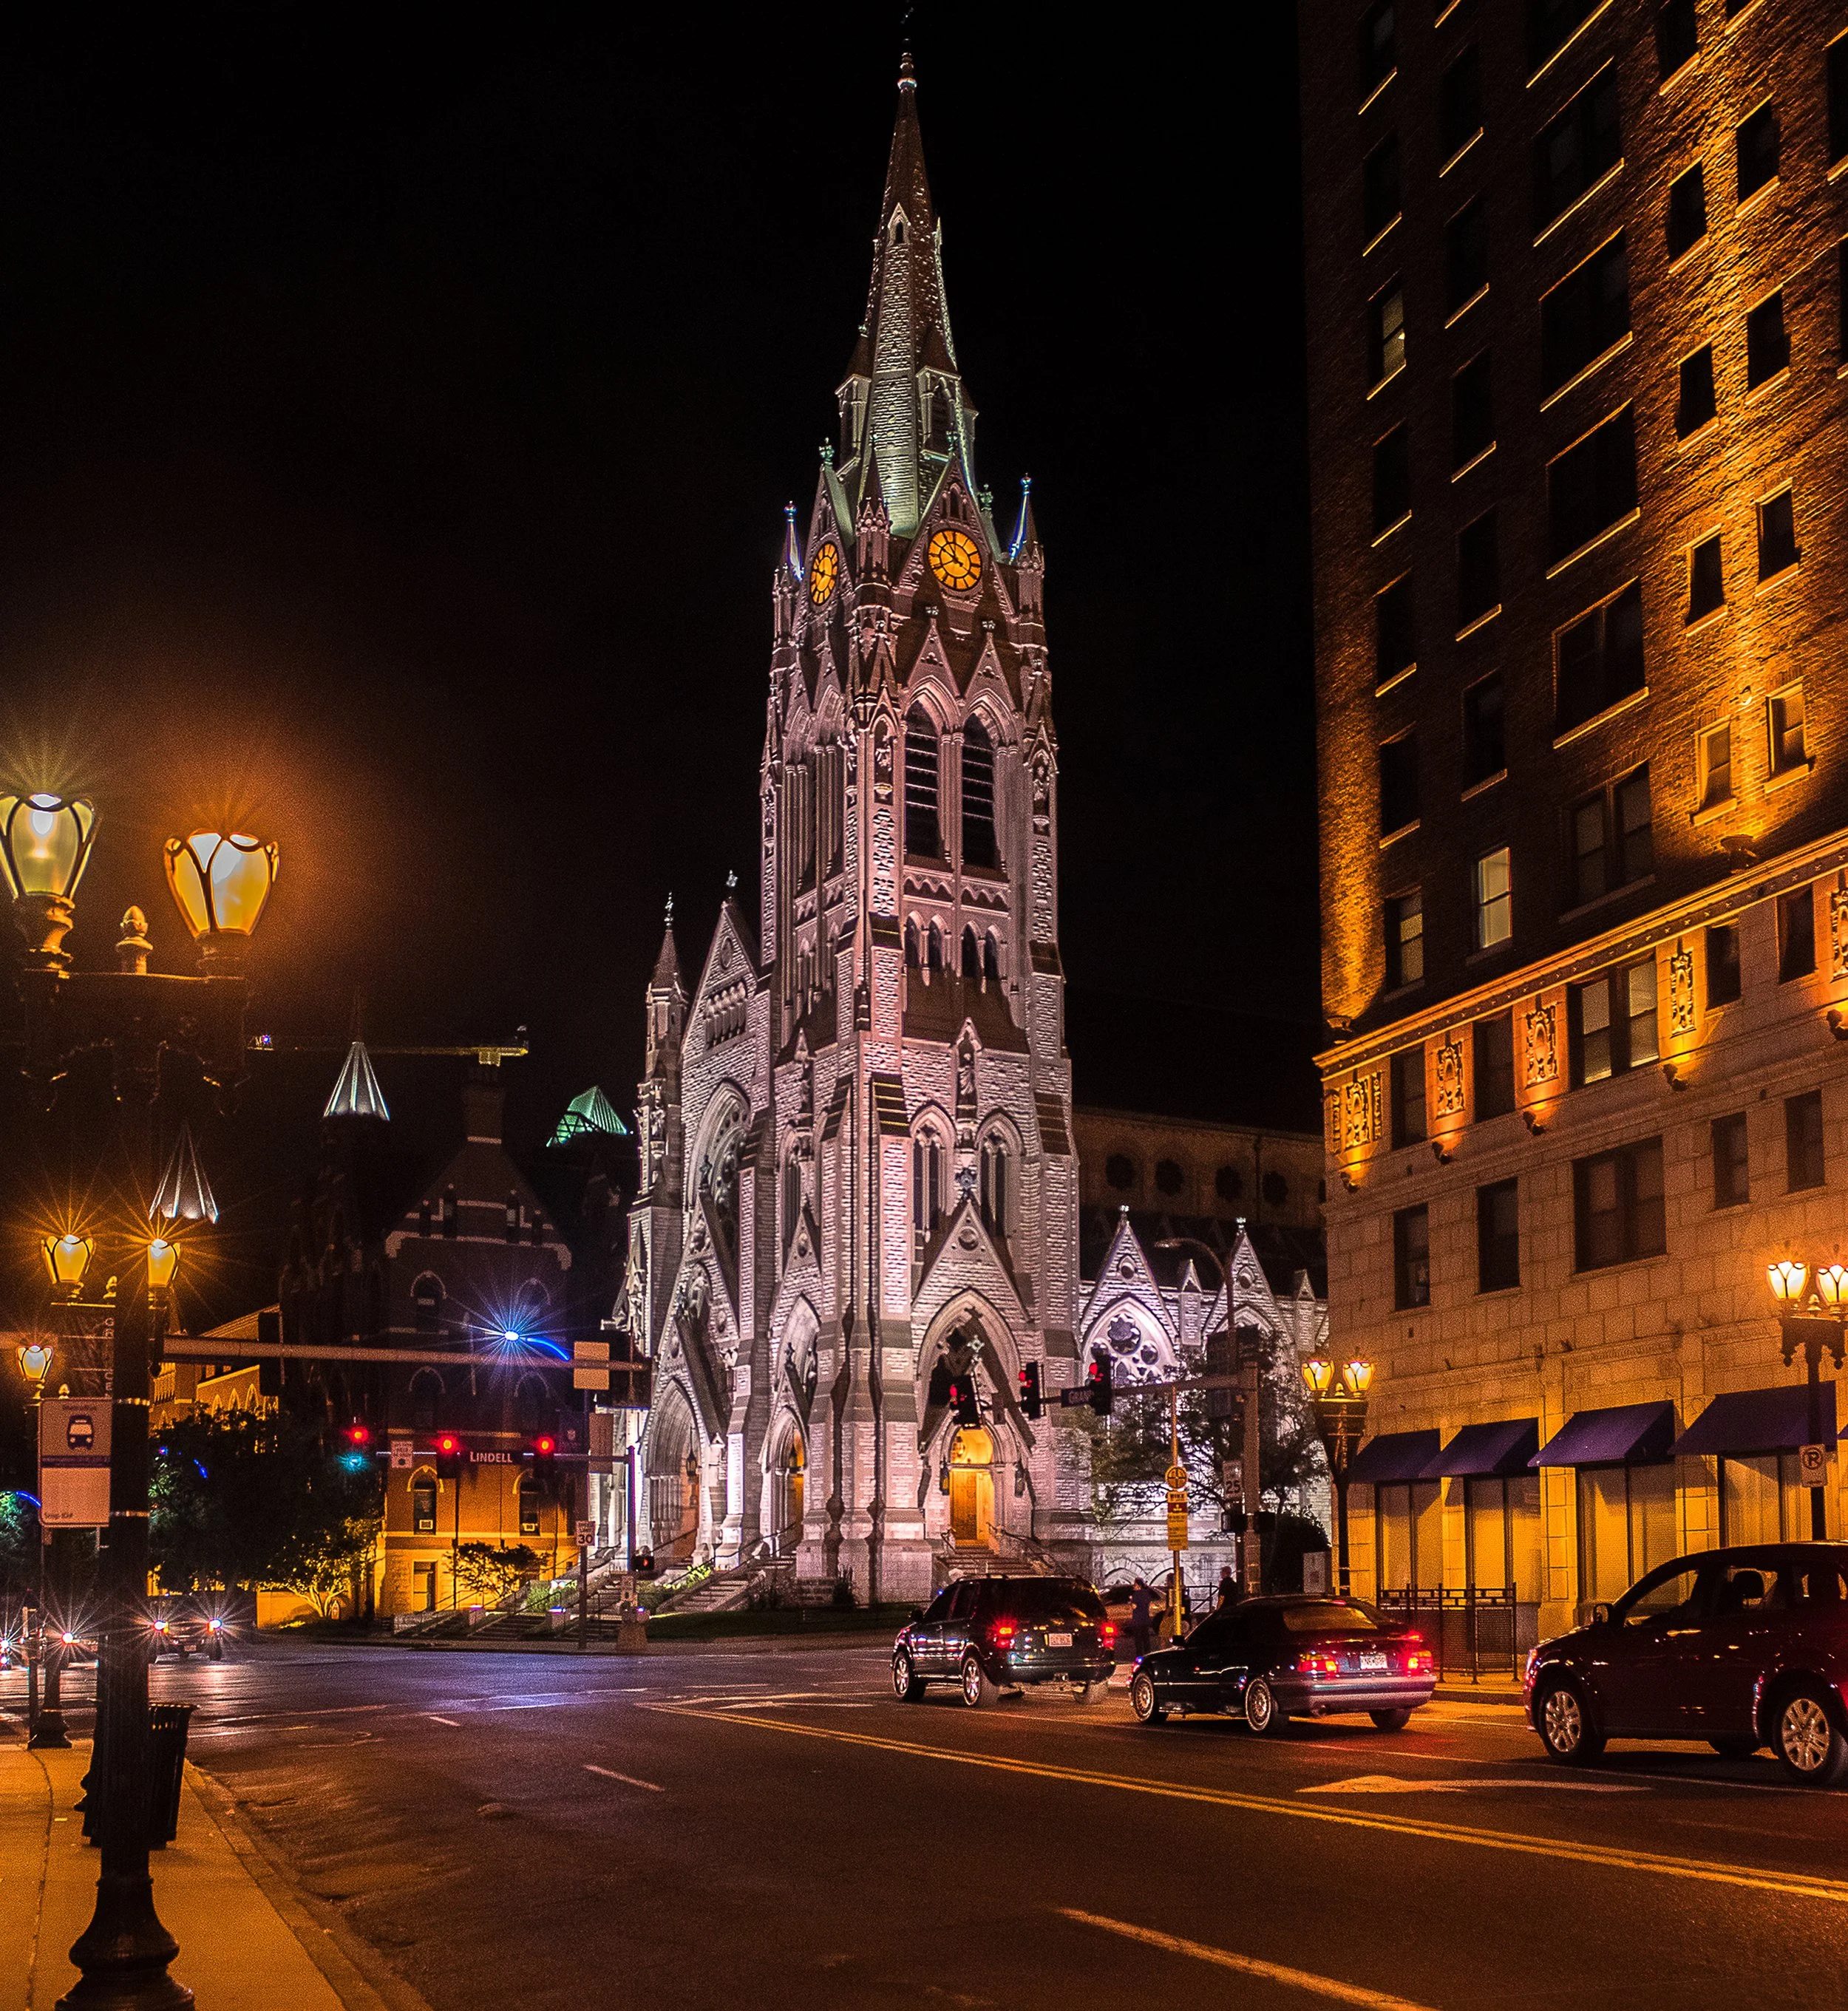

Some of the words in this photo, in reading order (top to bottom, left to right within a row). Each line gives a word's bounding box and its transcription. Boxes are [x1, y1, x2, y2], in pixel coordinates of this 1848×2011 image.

[469, 1451, 513, 1463] LINDELL
[1226, 1480, 1241, 1494] 25
[578, 1534, 593, 1544] 30
